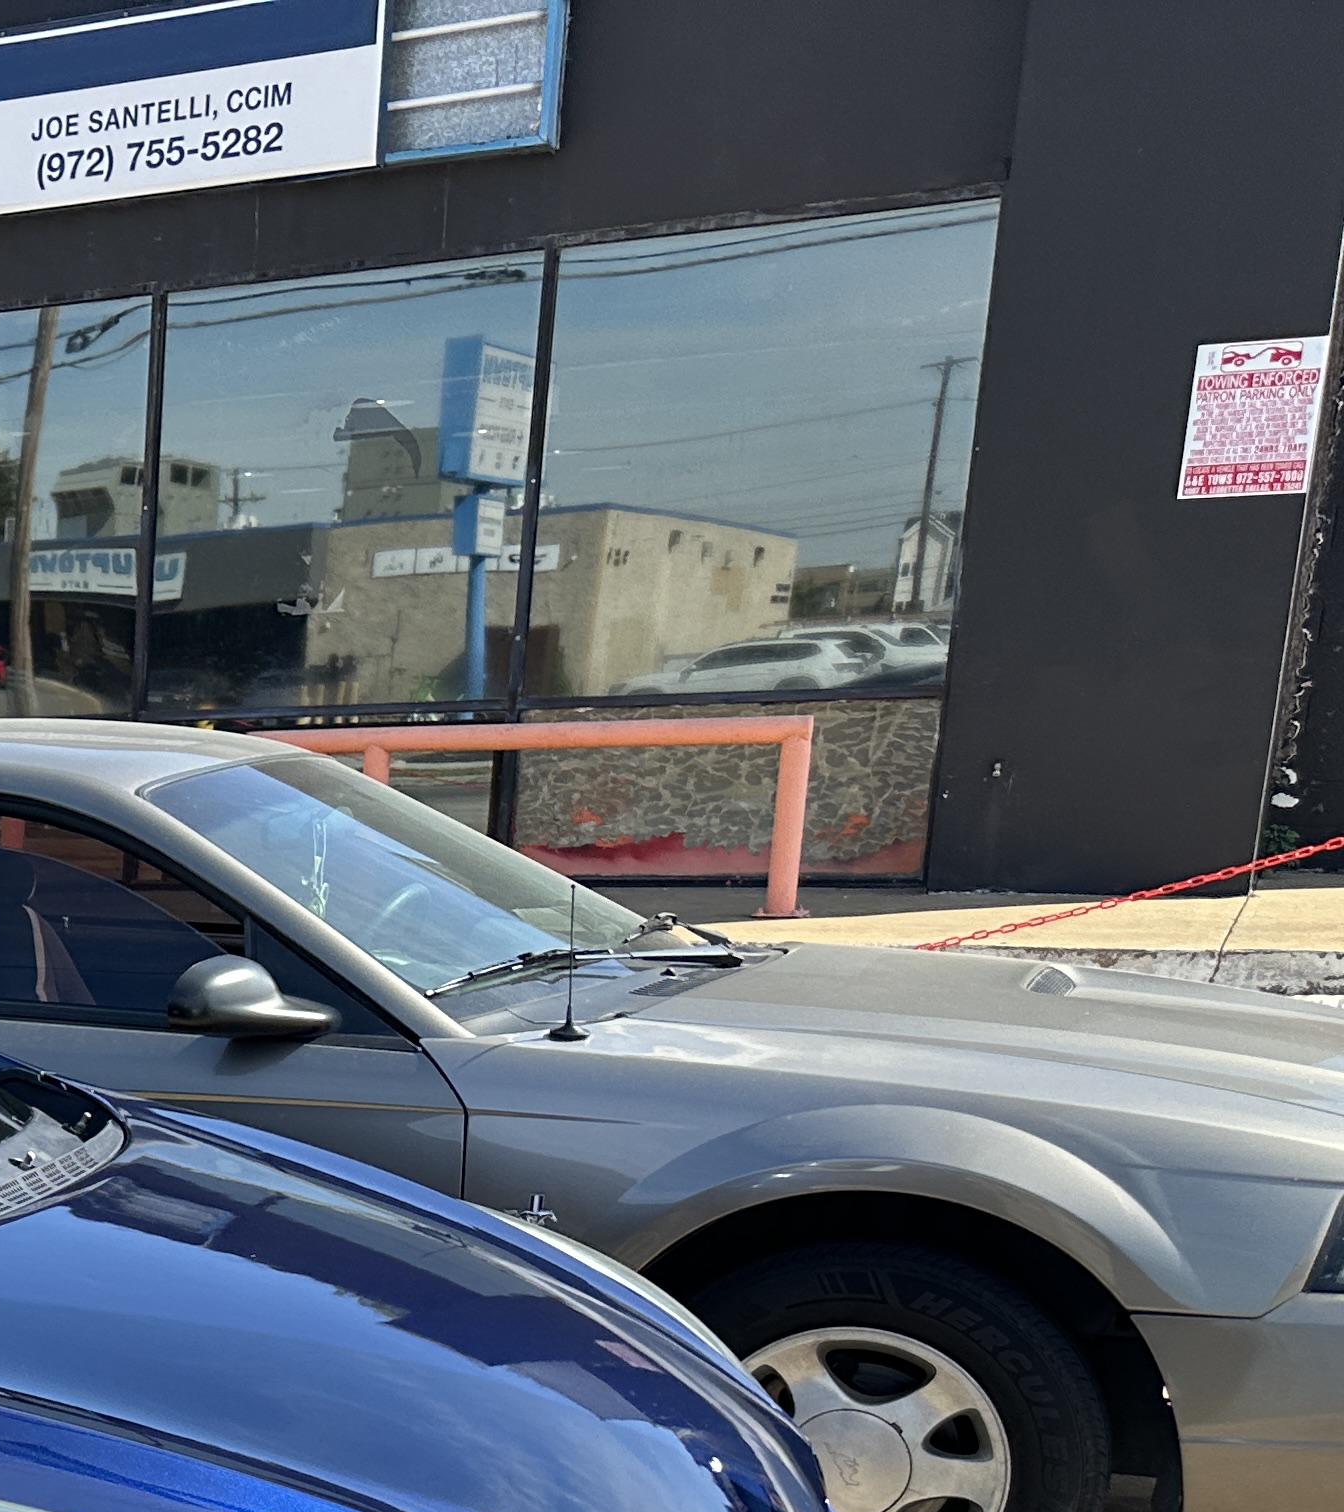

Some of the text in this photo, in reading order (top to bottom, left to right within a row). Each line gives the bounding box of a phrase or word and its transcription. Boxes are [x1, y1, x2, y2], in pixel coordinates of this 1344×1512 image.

[31, 82, 293, 141] JOE SANTELLI, CCIM
[37, 122, 284, 190] (972) 755-5282
[1196, 384, 1317, 404] PATRON PARKING ONLY
[1199, 369, 1319, 390] TOWING ENFORCED
[1207, 473, 1233, 486] TOWS
[909, 1291, 1075, 1494] HERCULES
